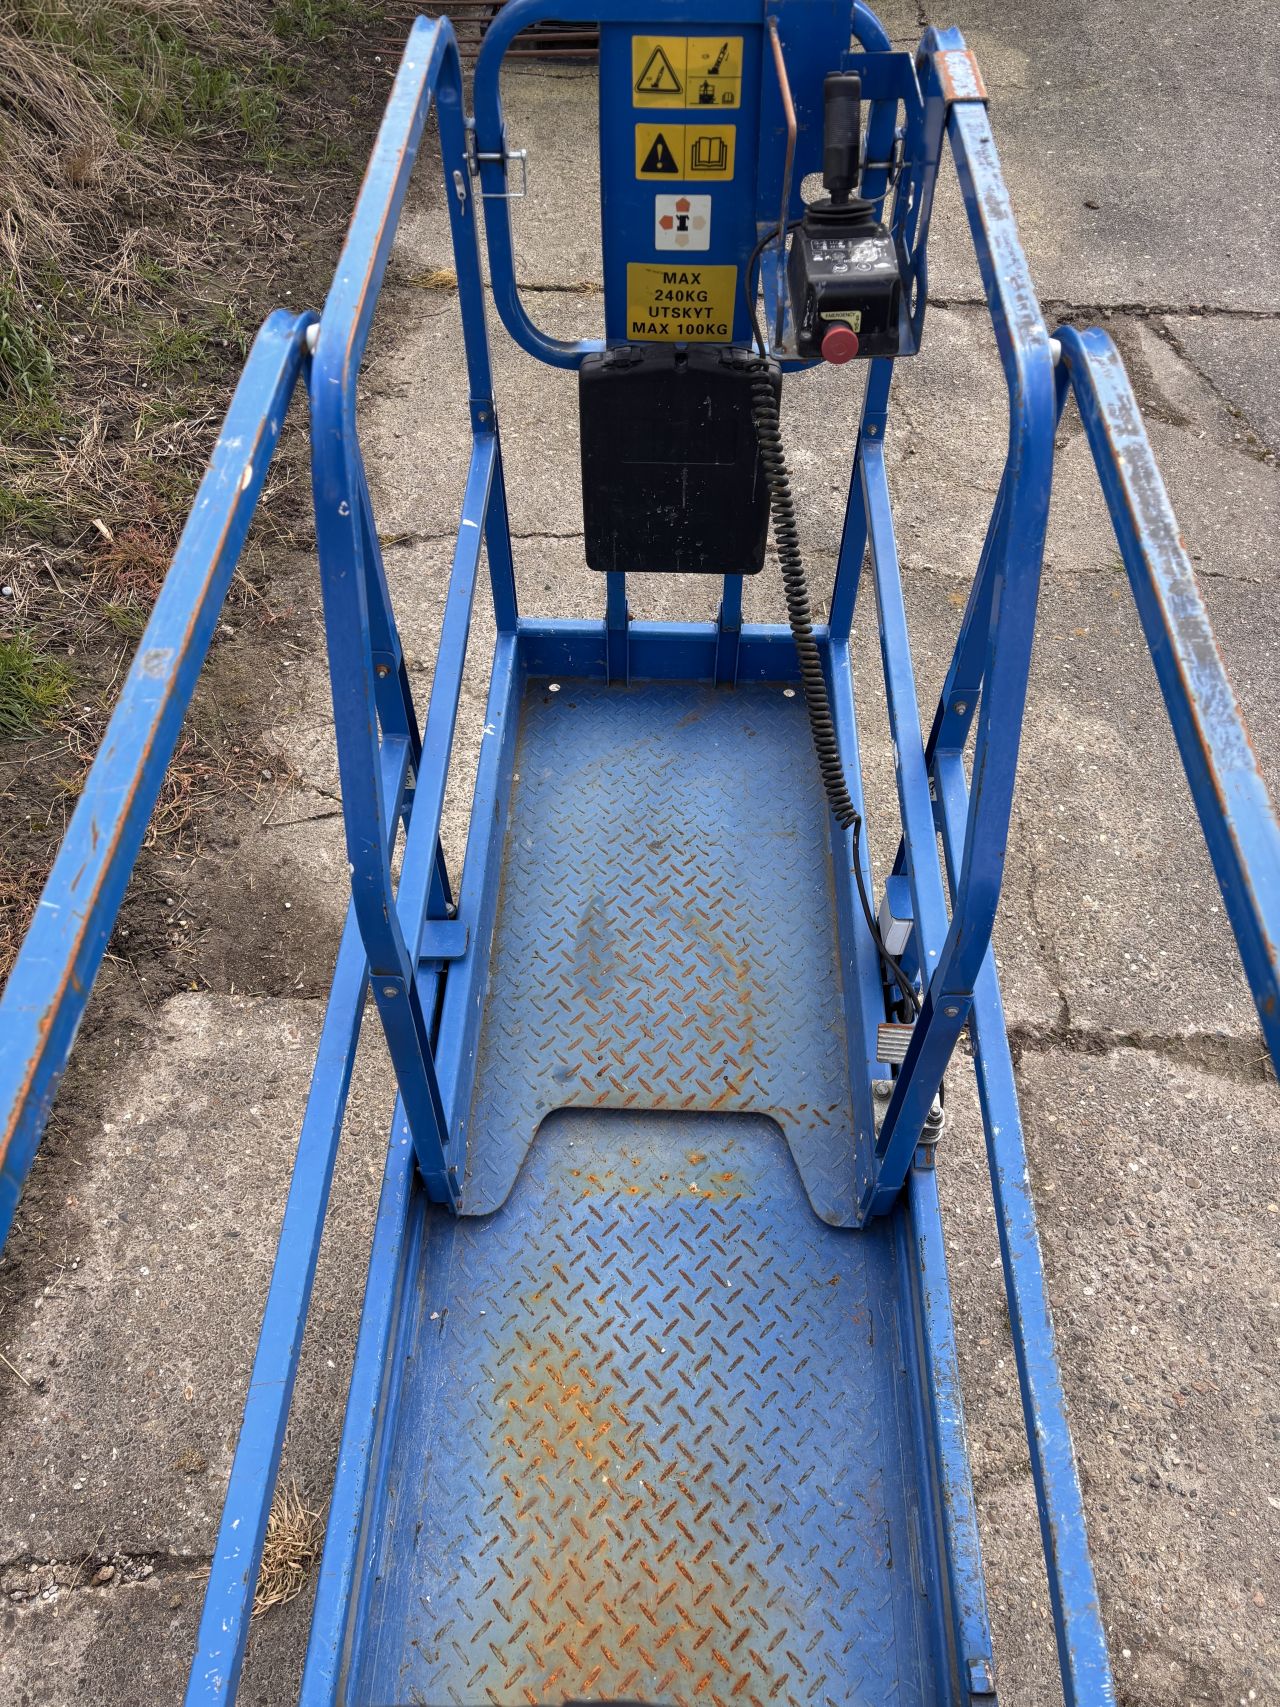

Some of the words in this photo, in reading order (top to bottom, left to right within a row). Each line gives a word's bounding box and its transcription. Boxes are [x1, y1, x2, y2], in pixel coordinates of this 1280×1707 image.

[663, 272, 701, 284] MAX
[654, 289, 708, 302] 240KG
[648, 306, 714, 319] UTSKYT
[632, 322, 669, 334] MAX
[677, 323, 728, 335] 100KG
